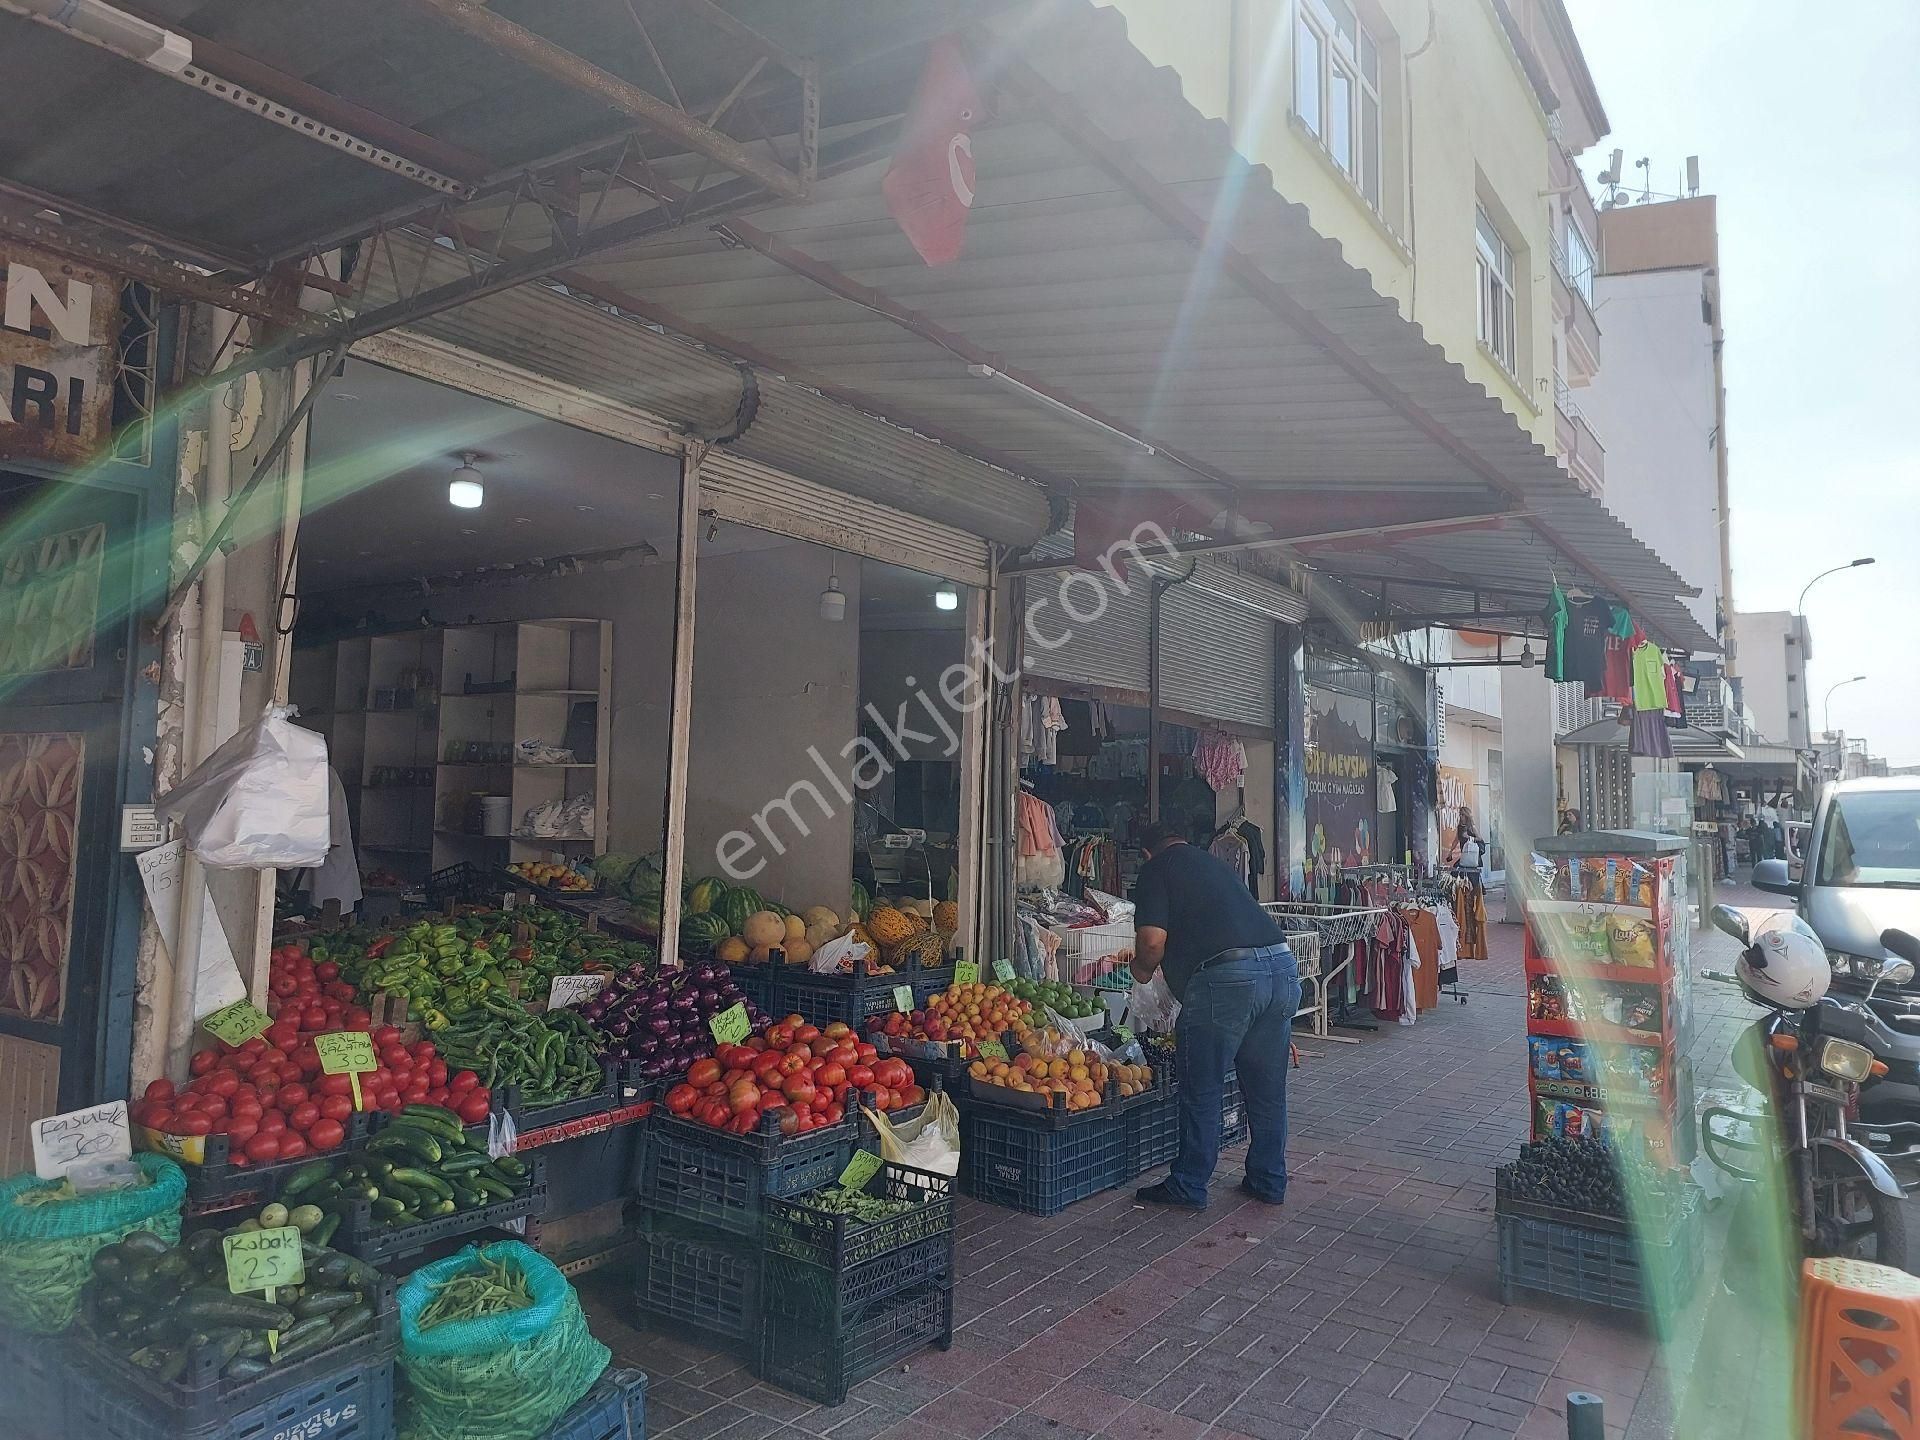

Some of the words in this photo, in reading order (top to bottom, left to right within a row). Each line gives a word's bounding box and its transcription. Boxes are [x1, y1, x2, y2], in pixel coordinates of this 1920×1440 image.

[1577, 903, 1595, 915] 15
[1612, 927, 1640, 943] Lay's
[234, 1016, 256, 1035] 25
[336, 1053, 370, 1068] 30
[57, 1133, 114, 1165] 30
[226, 1230, 295, 1259] Kabak
[243, 1255, 281, 1280] 25
